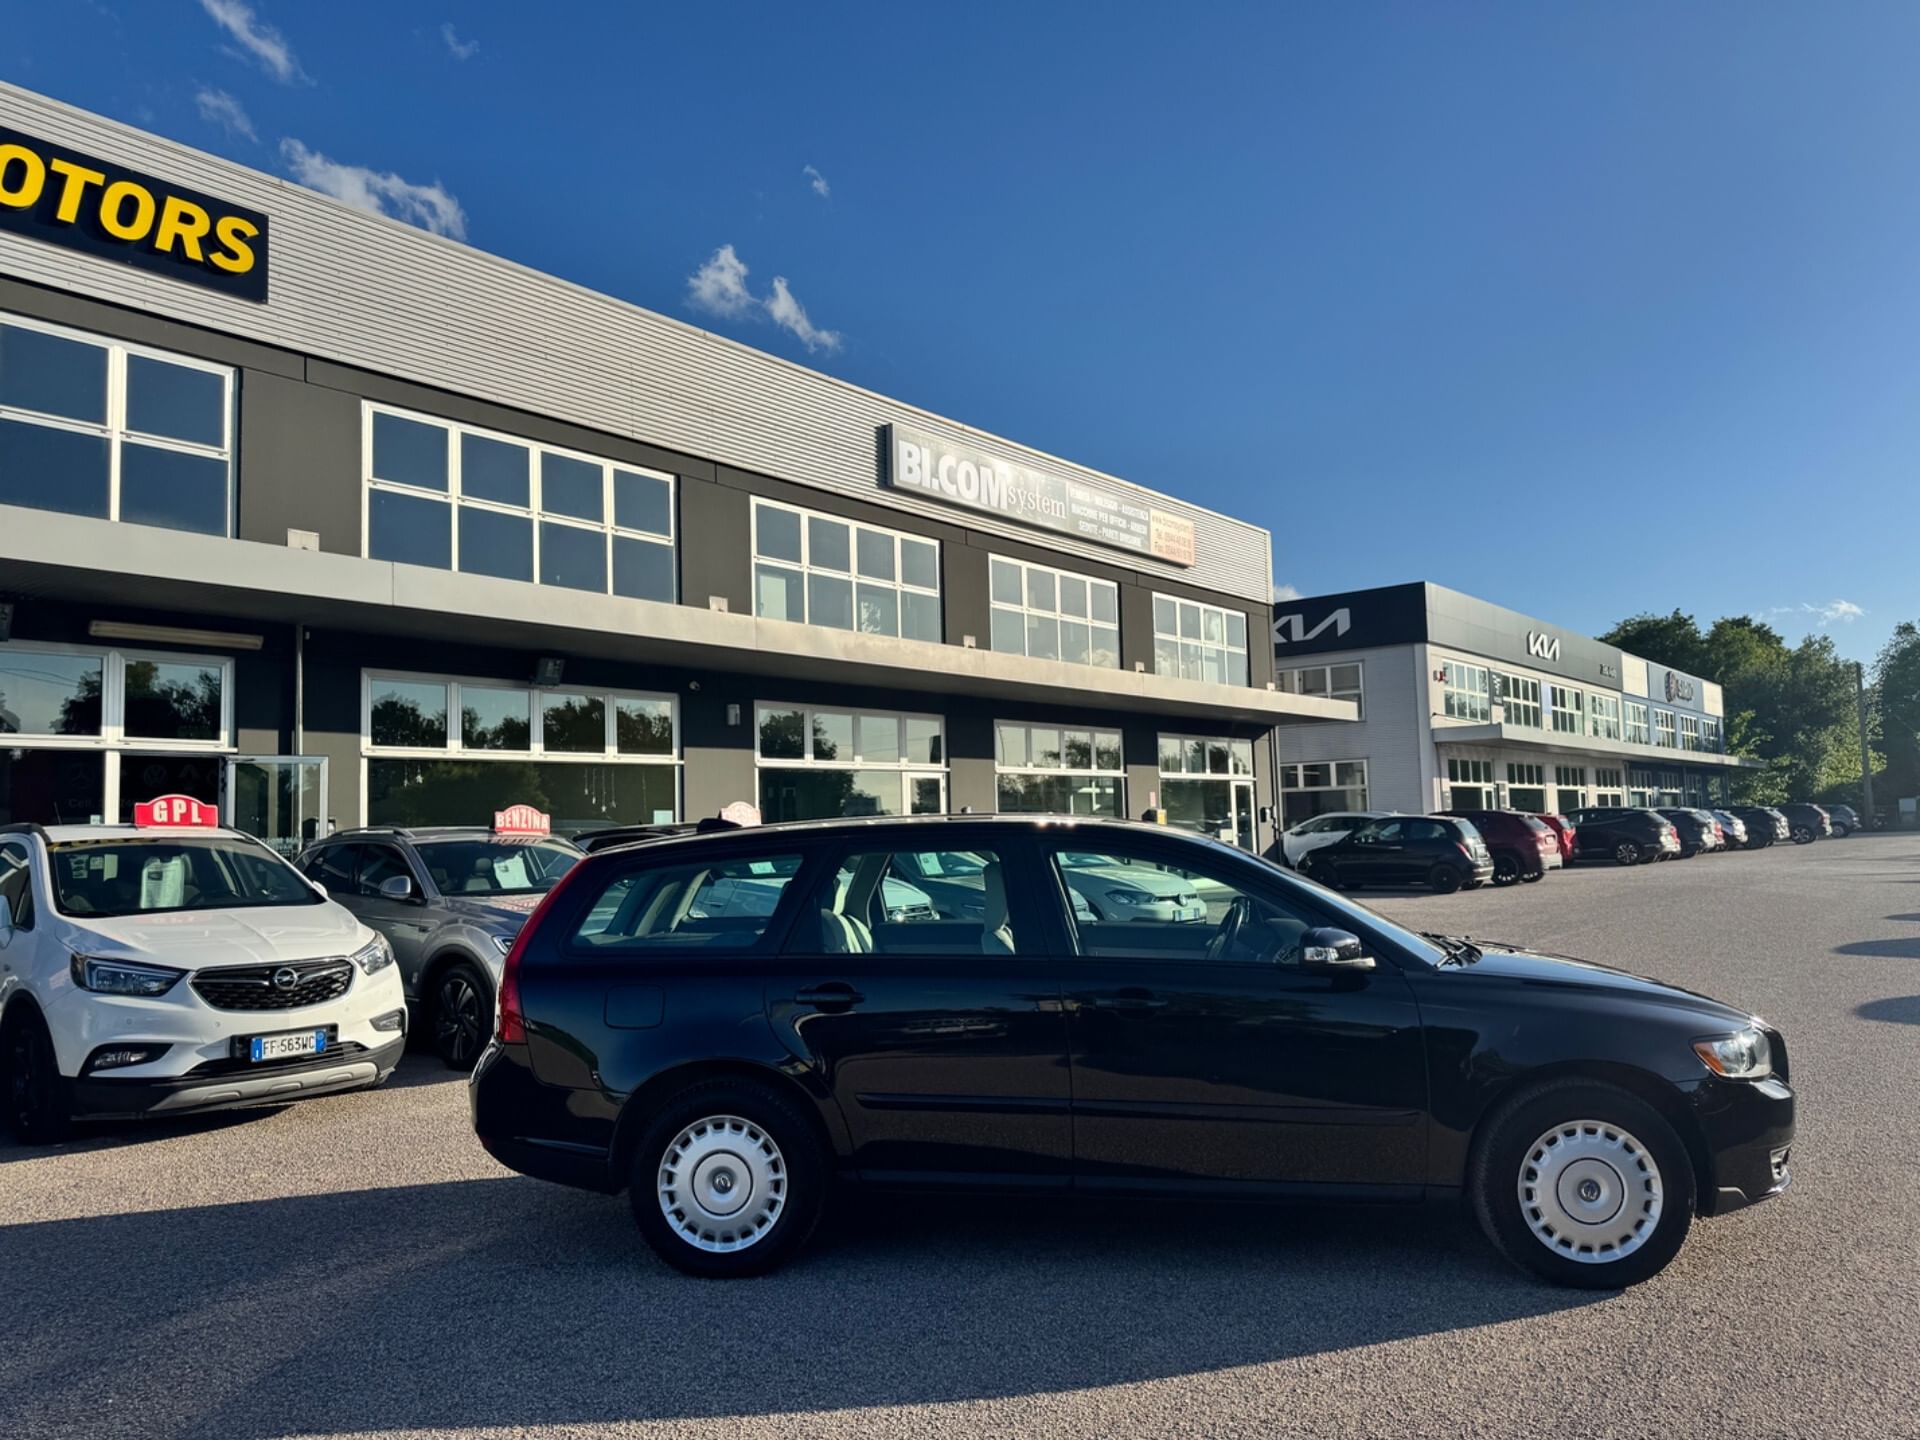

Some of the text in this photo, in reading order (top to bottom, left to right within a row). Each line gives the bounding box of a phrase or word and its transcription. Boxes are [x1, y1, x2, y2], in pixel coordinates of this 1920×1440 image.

[899, 440, 1067, 519] BI.COM system
[1529, 630, 1560, 662] KIA
[153, 798, 202, 824] GPL
[496, 807, 548, 829] BENZINA
